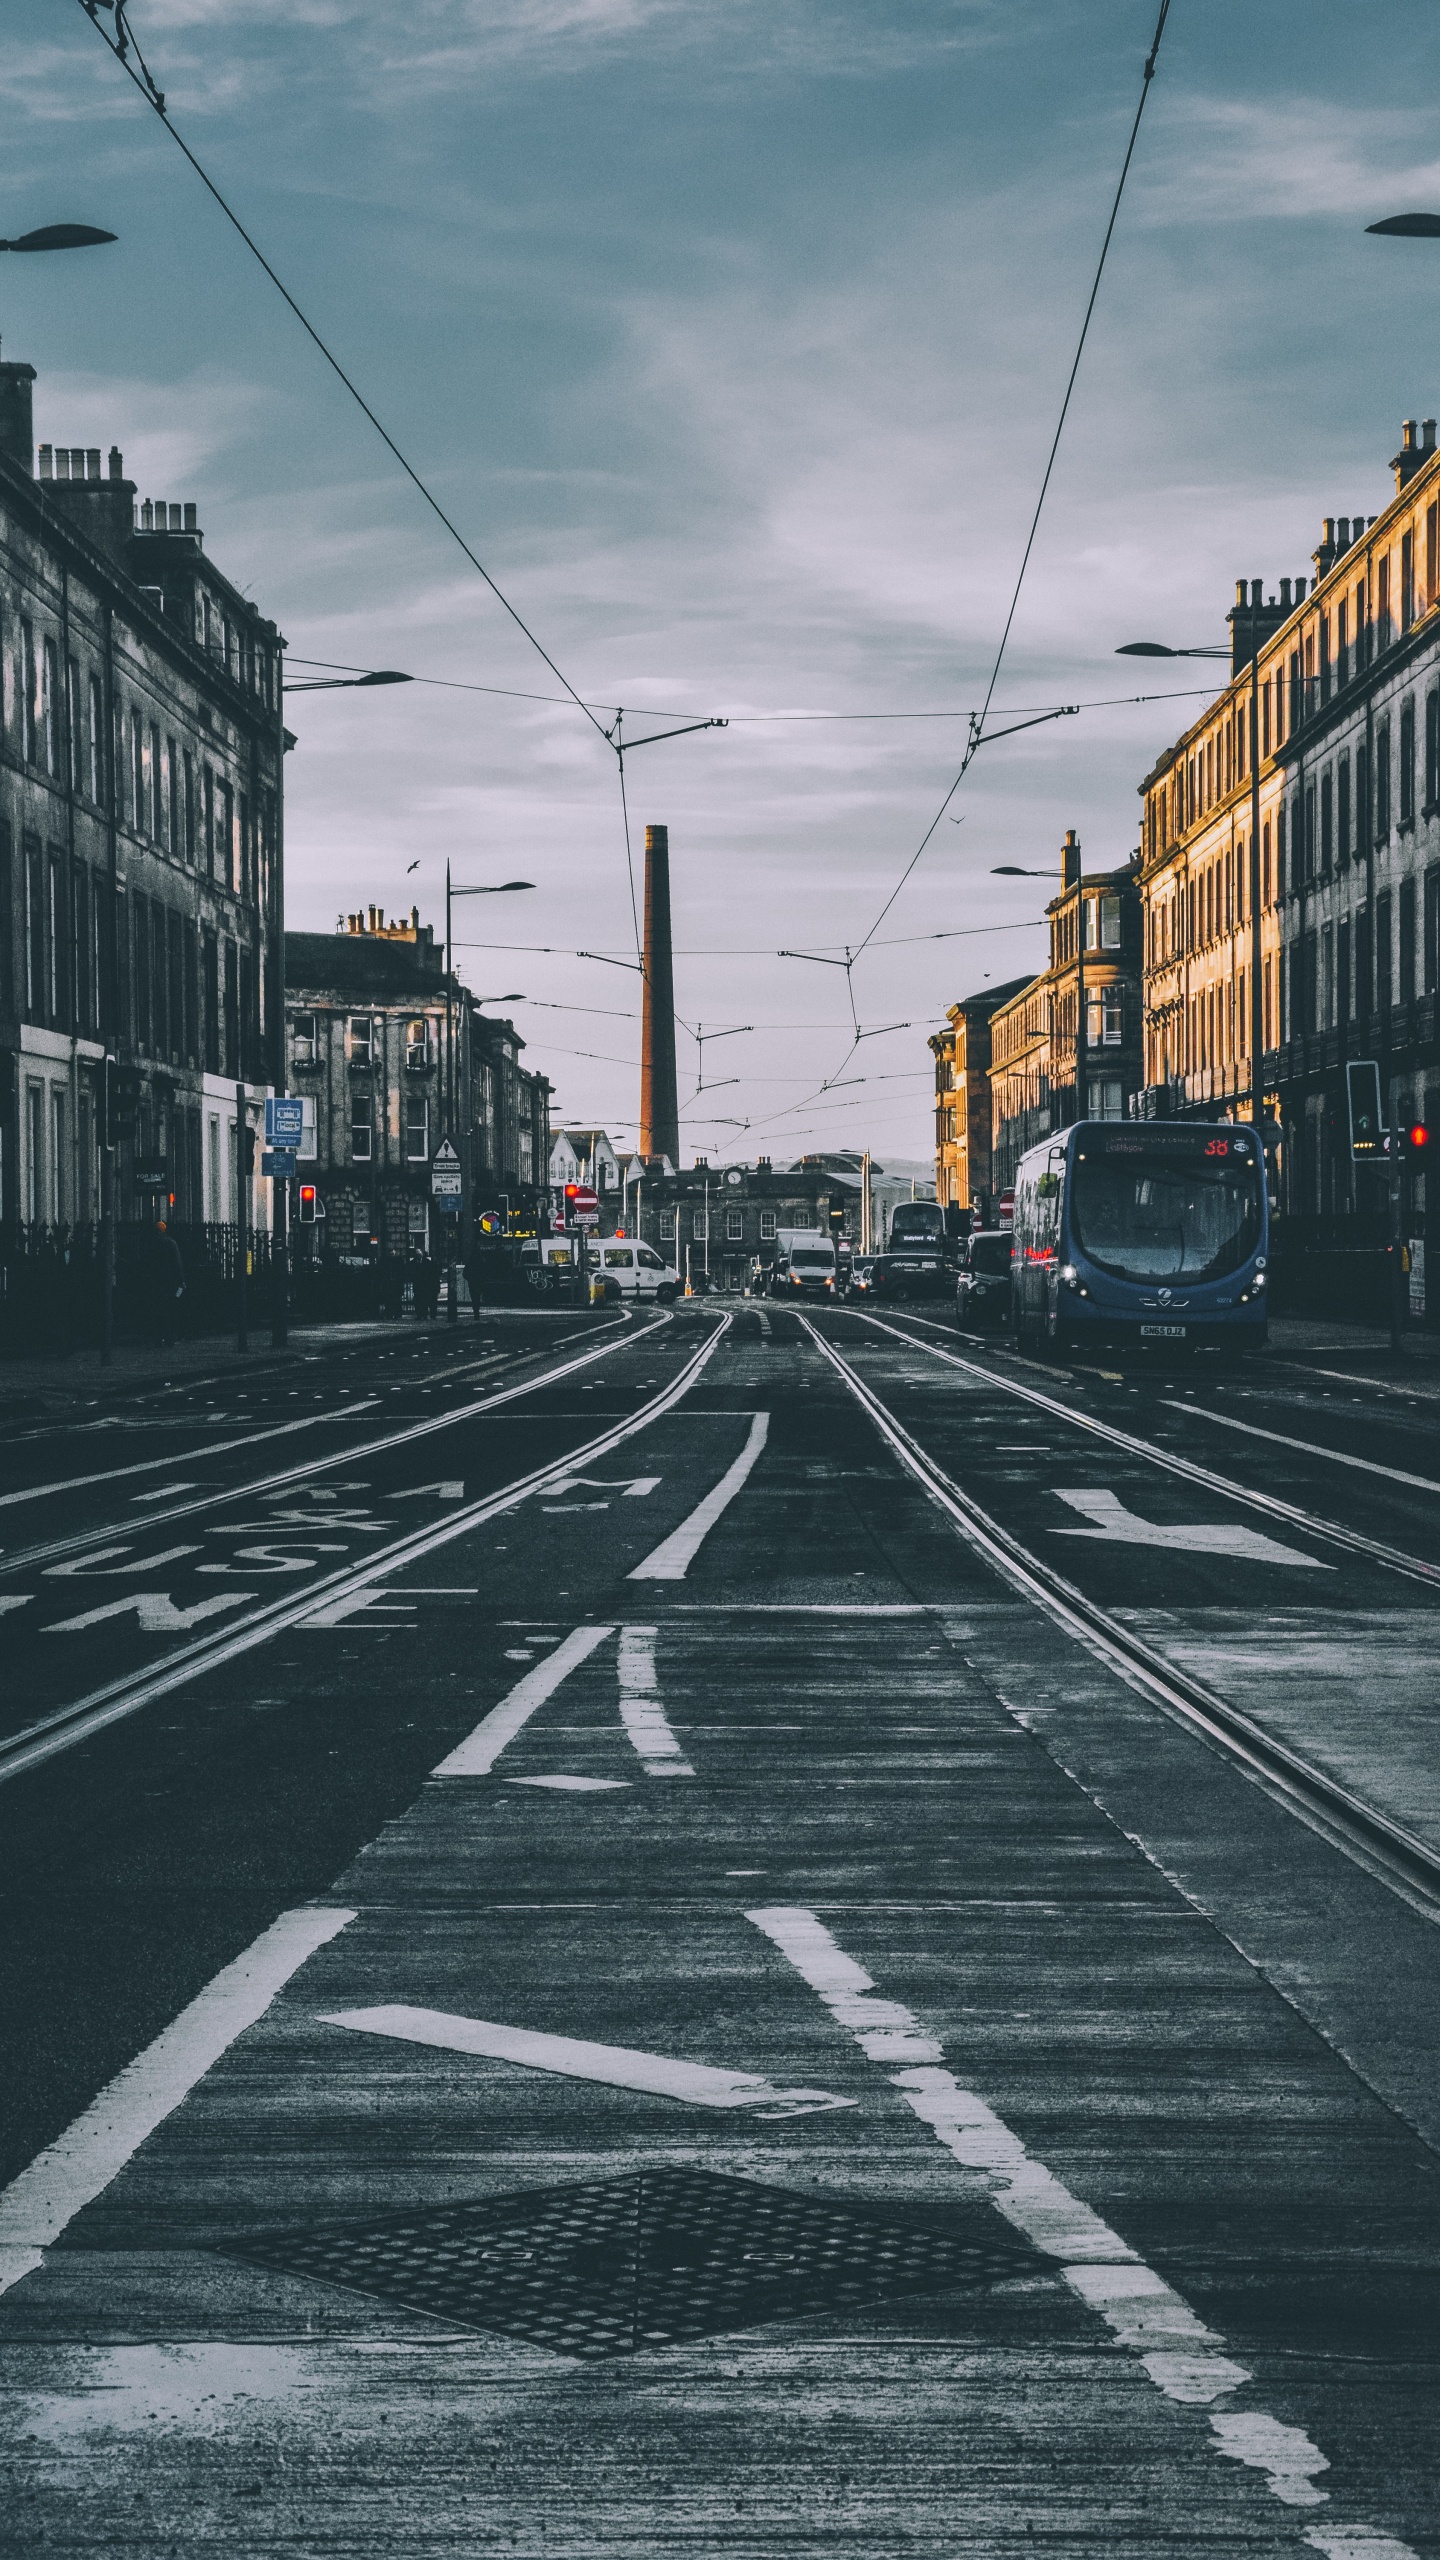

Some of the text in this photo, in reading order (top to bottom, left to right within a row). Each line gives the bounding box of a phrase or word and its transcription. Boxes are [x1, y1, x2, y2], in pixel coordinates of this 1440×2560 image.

[1204, 1139, 1229, 1156] 38
[1143, 1326, 1165, 1335] SN65
[129, 1477, 664, 1502] TRAM
[0, 1543, 349, 1576] US
